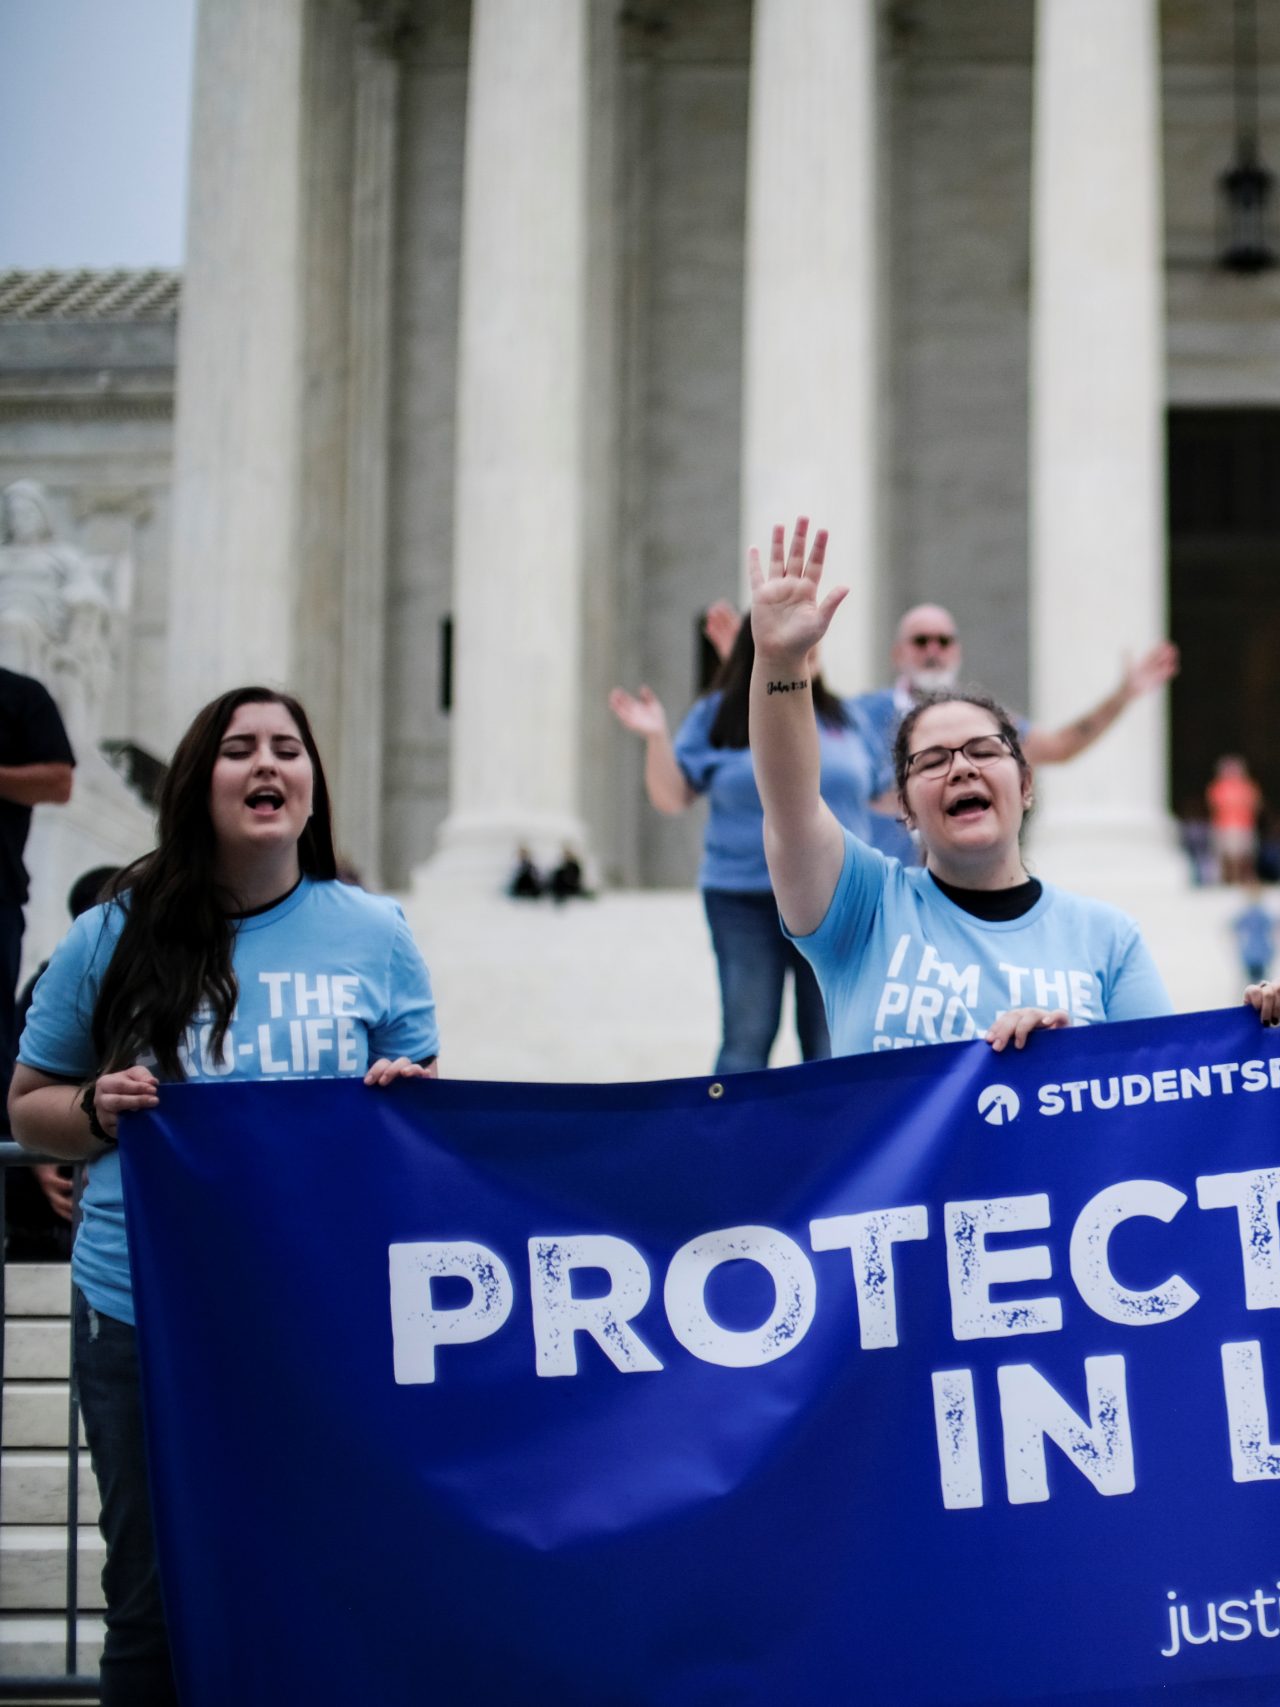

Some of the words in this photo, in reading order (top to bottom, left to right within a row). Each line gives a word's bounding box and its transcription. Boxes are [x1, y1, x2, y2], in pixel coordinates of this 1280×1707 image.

[258, 972, 361, 1019] THE
[887, 934, 911, 978] I
[999, 962, 1098, 1023] THE
[931, 1354, 1136, 1510] IN
